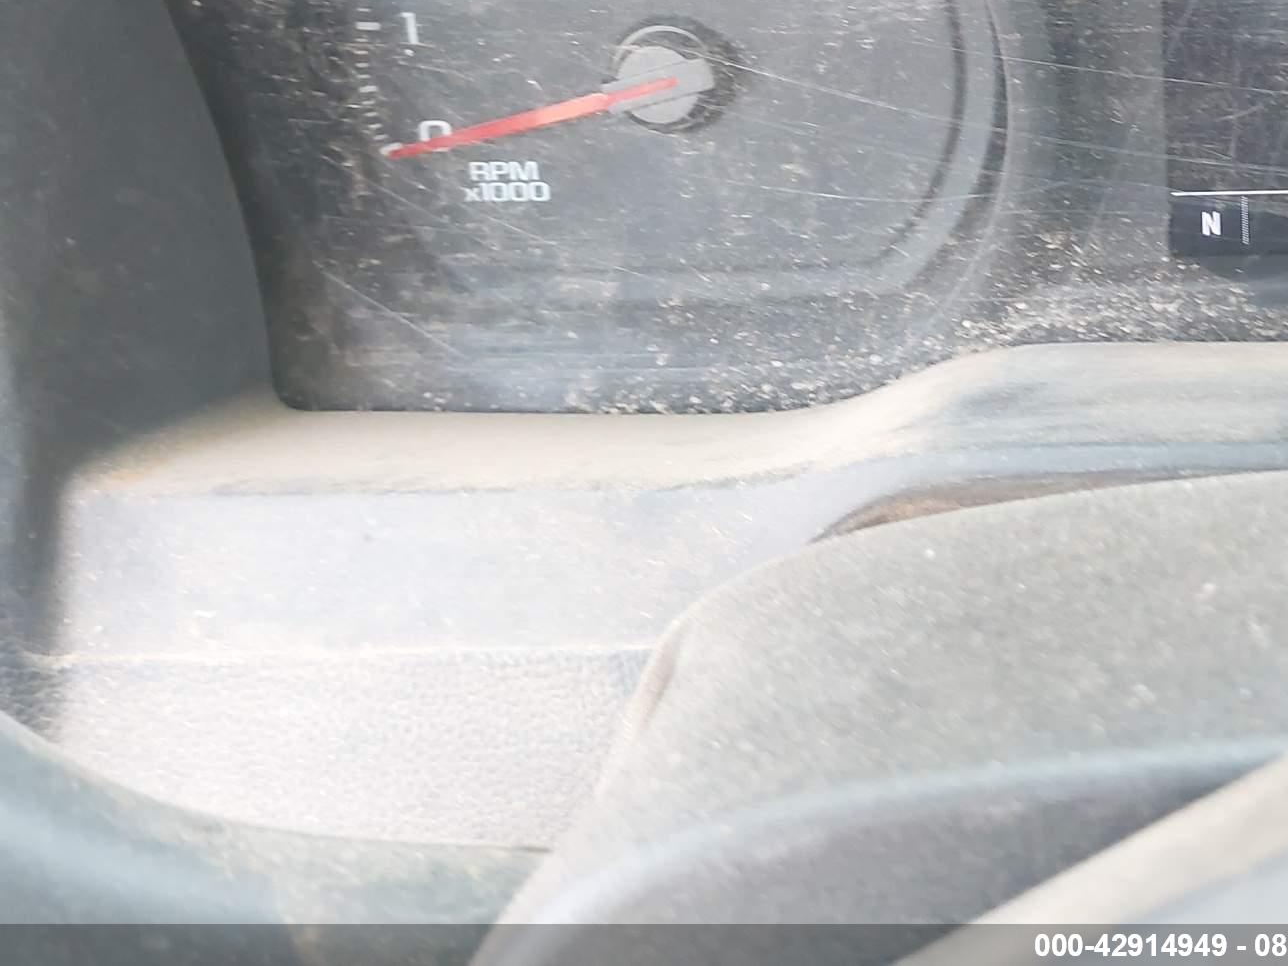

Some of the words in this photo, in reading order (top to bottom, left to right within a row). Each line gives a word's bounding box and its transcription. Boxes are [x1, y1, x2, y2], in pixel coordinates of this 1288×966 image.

[400, 11, 419, 45] 1
[419, 120, 452, 152] 0
[468, 160, 541, 181] RPM
[463, 181, 551, 203] x1000
[1201, 210, 1222, 236] N
